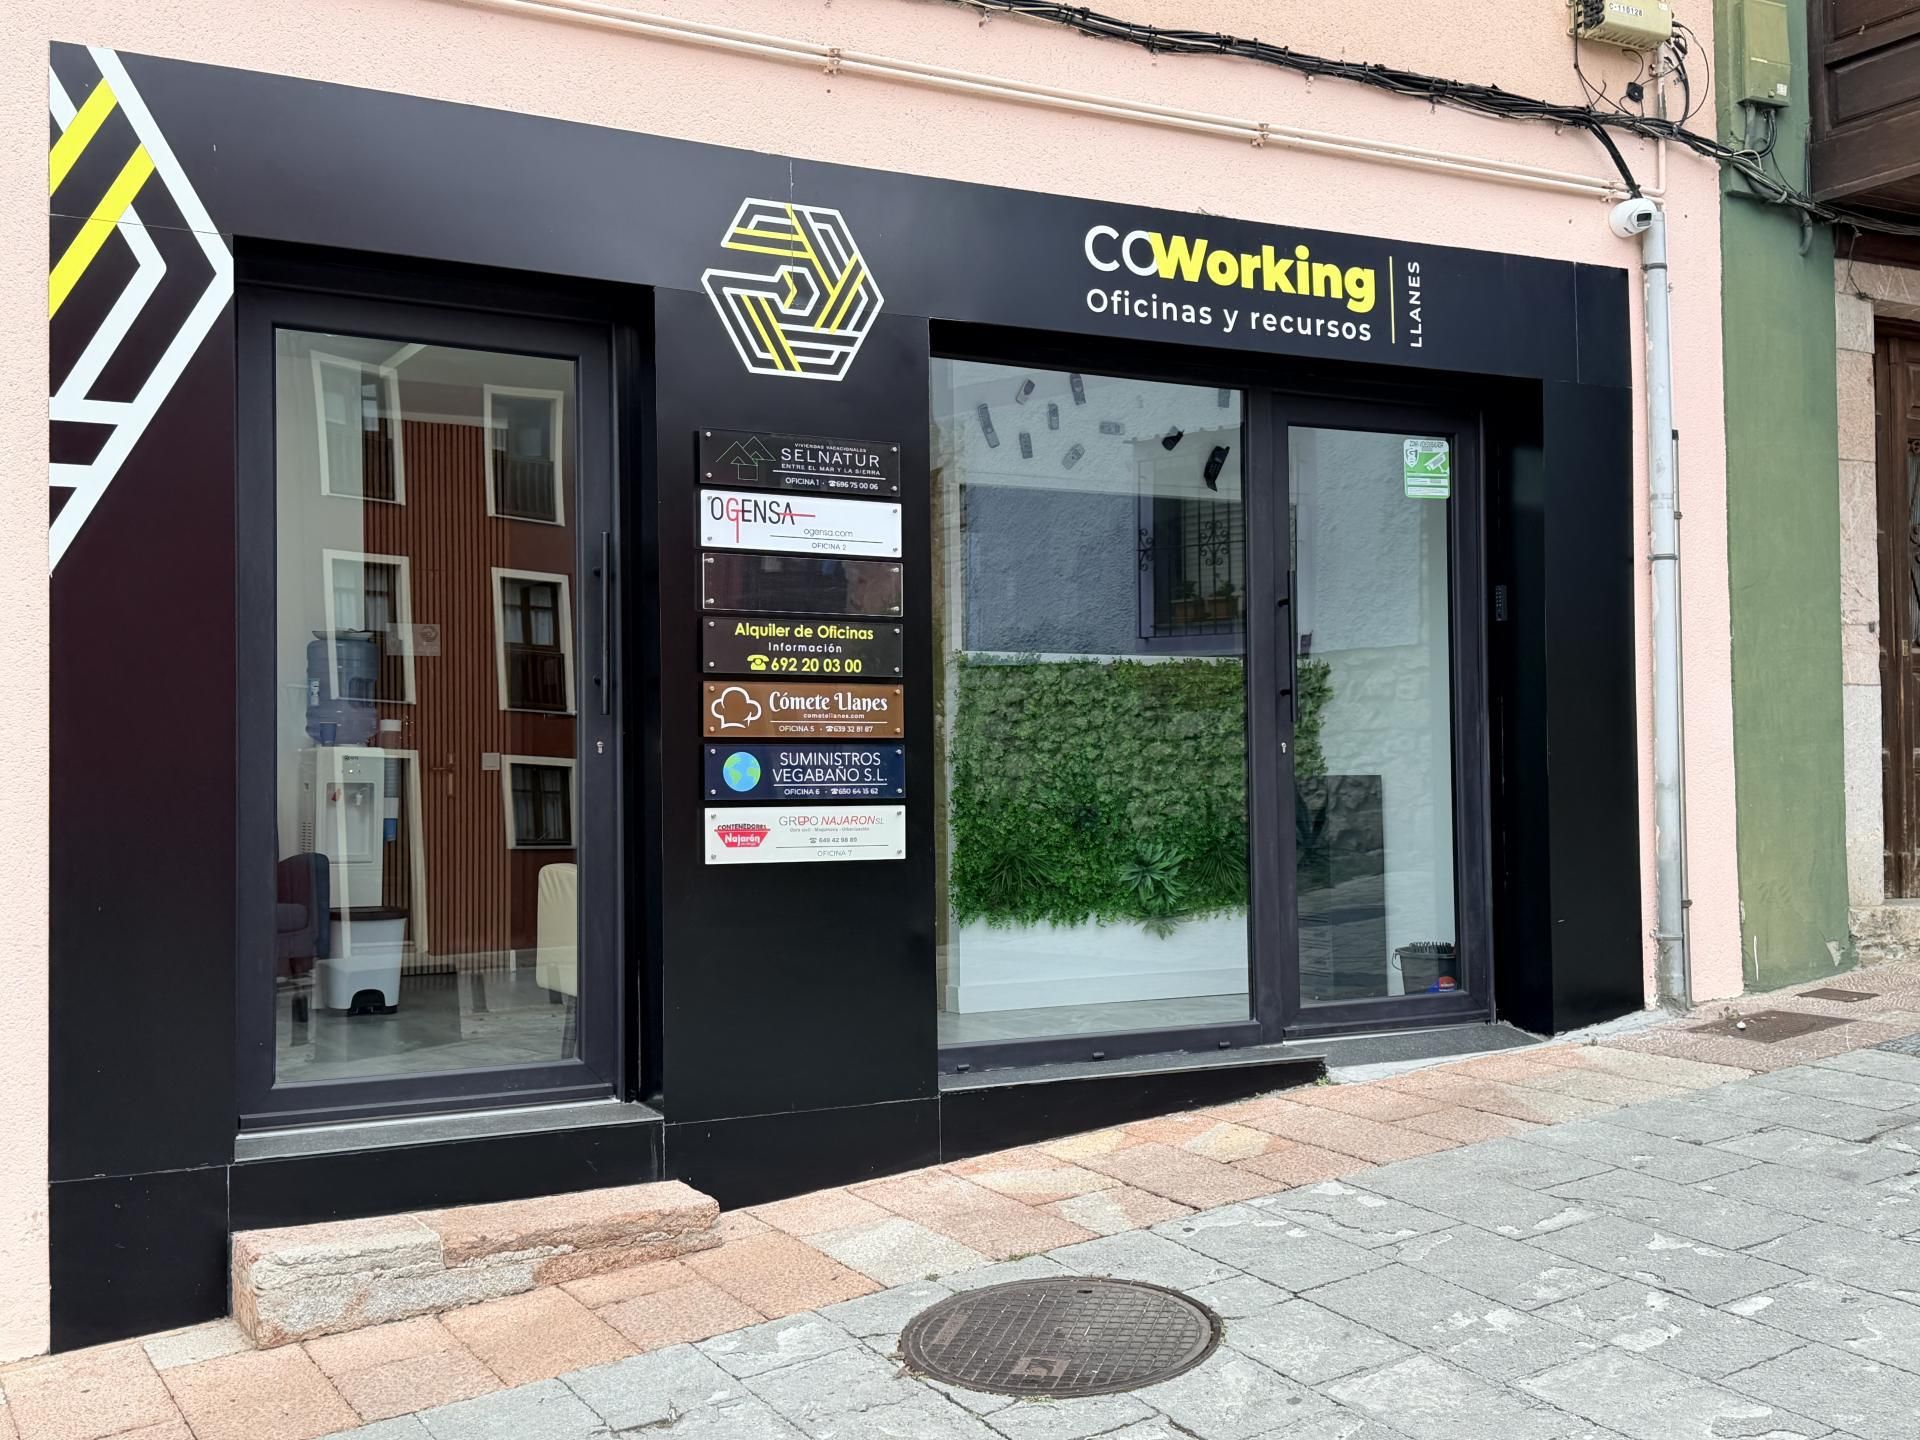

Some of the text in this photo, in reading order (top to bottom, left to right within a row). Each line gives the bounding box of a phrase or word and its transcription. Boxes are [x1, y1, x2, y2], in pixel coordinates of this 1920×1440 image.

[1084, 225, 1375, 313] COWorking
[1408, 261, 1423, 348] LLANES
[1087, 289, 1372, 341] Oficinas y recursos
[781, 448, 880, 468] SELNATUR
[785, 477, 815, 486] OFICINA
[710, 496, 806, 536] OGENSA
[804, 527, 853, 538] ogensa.com
[812, 542, 841, 551] OFICINA
[734, 623, 874, 640] Alquiler de Oficinas
[768, 642, 842, 653] Información
[771, 657, 862, 673] 692 20 03 00
[769, 691, 888, 712] Cómete Llanes
[780, 752, 881, 766] SUMINISTROS
[772, 766, 888, 782] VEGABAÑO S.L.
[779, 816, 818, 826] GRUPO
[821, 815, 875, 825] NAJARON
[725, 833, 760, 846] Najarón
